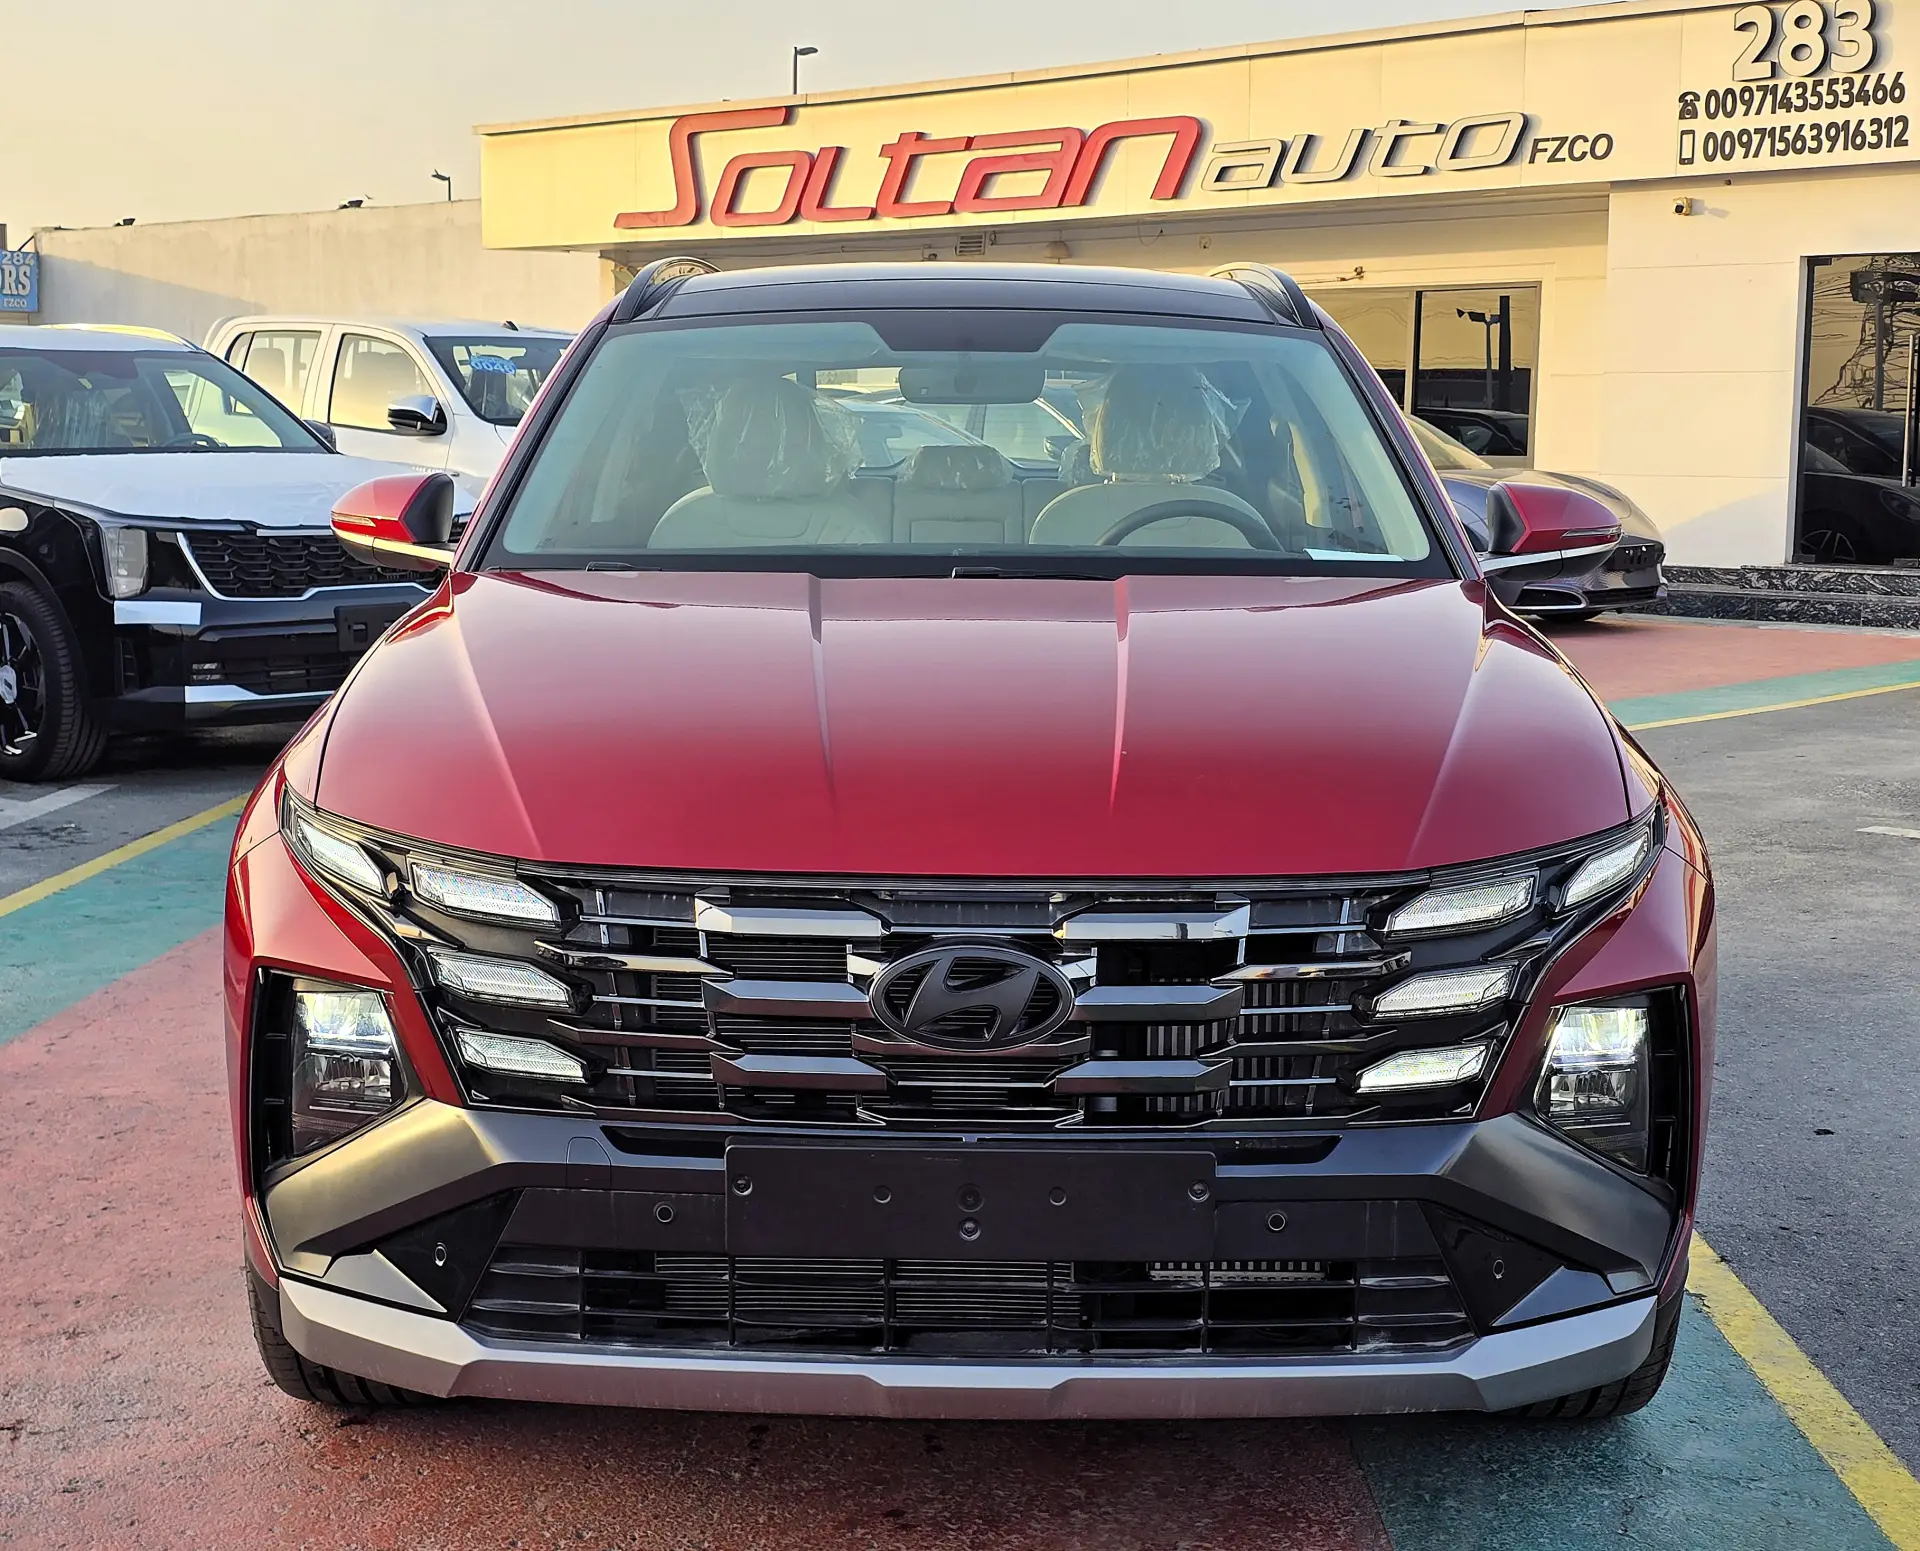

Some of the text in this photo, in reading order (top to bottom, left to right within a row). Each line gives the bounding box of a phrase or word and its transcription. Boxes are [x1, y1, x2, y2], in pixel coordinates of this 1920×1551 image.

[1733, 0, 1877, 81] 283
[1704, 72, 1906, 120] 0097143553466
[1201, 112, 1530, 192] auto
[1529, 133, 1614, 165] FZCO
[1703, 115, 1909, 162] 00971563916312
[0, 265, 31, 296] RS
